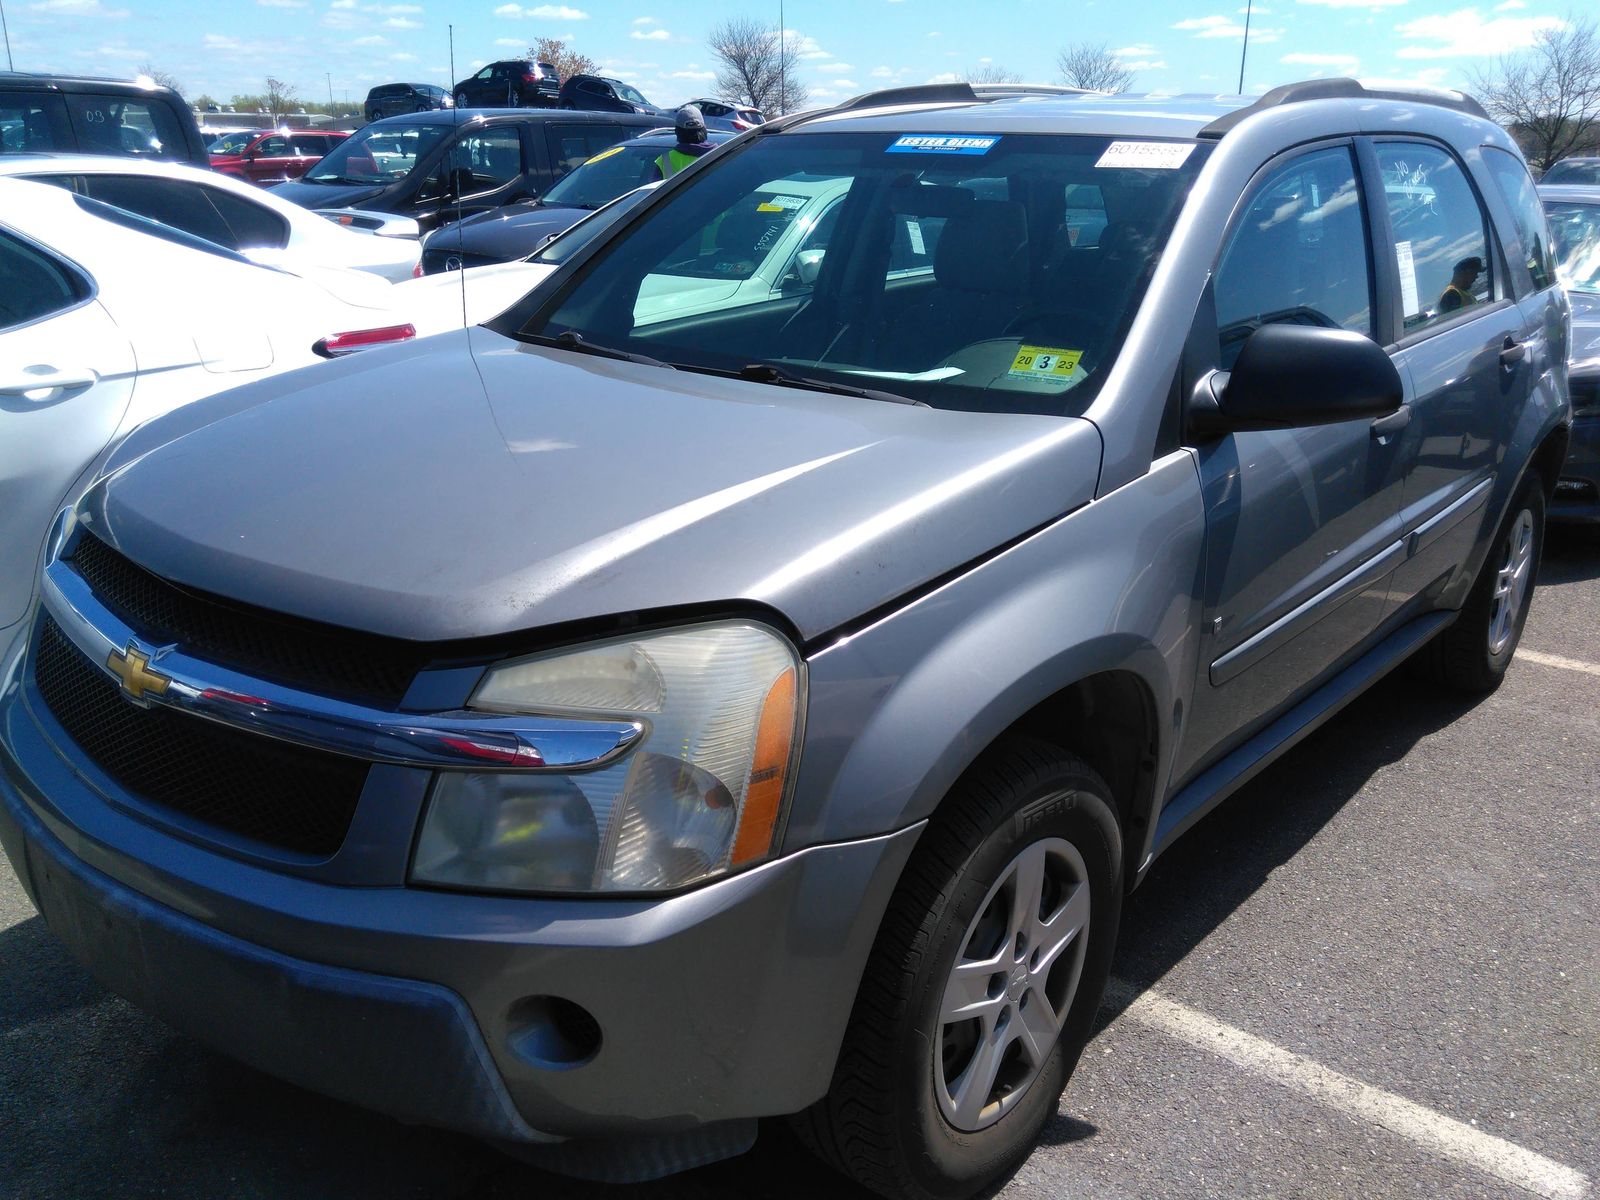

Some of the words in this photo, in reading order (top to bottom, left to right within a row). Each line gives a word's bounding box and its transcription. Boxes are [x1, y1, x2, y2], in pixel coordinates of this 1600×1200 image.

[896, 137, 945, 147] LESTER
[947, 138, 995, 149] GLENN
[1017, 356, 1033, 366] 20
[1039, 355, 1051, 369] 3
[1057, 360, 1074, 369] 23
